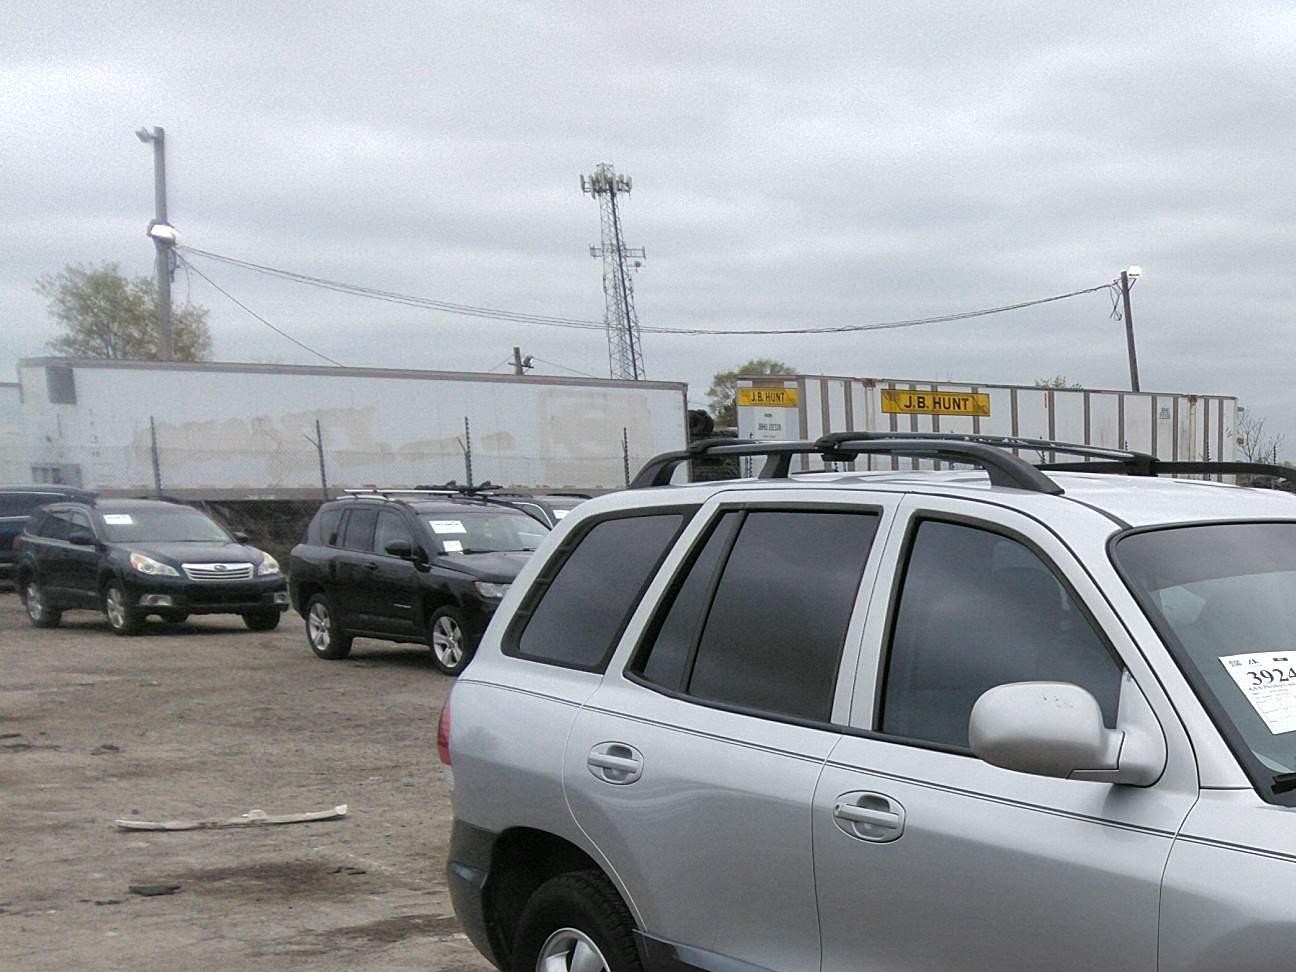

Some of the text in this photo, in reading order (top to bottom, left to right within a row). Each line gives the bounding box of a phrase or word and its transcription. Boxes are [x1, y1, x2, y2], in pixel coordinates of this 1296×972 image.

[752, 391, 785, 403] J.B. HUNT
[904, 395, 969, 410] J.B. HUNT
